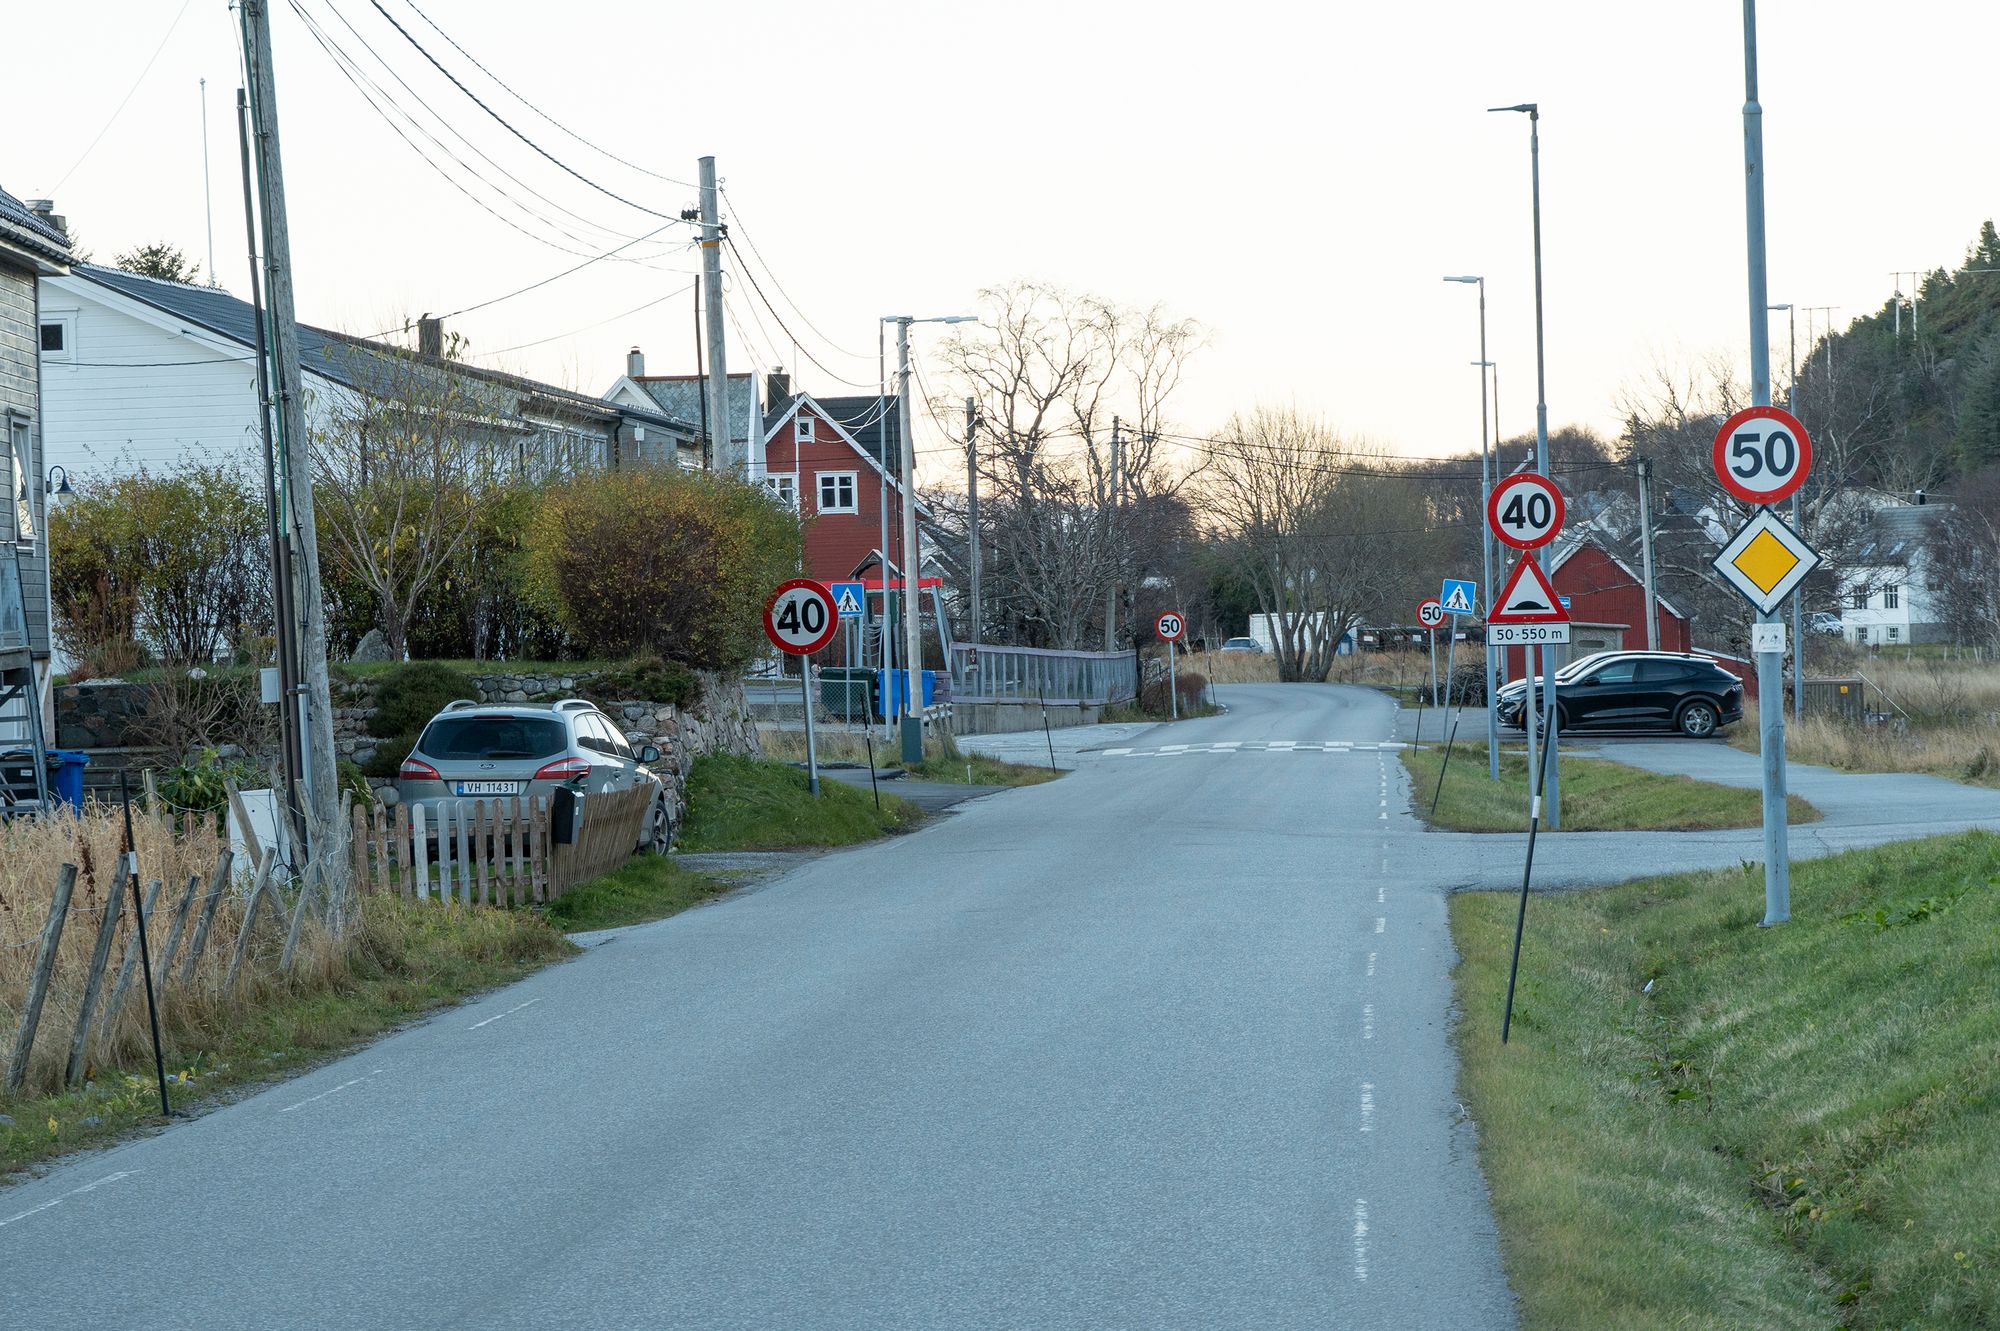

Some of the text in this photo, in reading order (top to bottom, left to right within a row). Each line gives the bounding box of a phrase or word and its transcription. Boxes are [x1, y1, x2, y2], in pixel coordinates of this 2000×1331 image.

[1732, 431, 1795, 478] 50
[1502, 492, 1551, 529] 40
[777, 597, 825, 634] 40
[1422, 606, 1441, 620] 50
[1161, 619, 1180, 633] 50
[1497, 628, 1562, 640] 50-550 m
[467, 783, 514, 792] VH 11431
